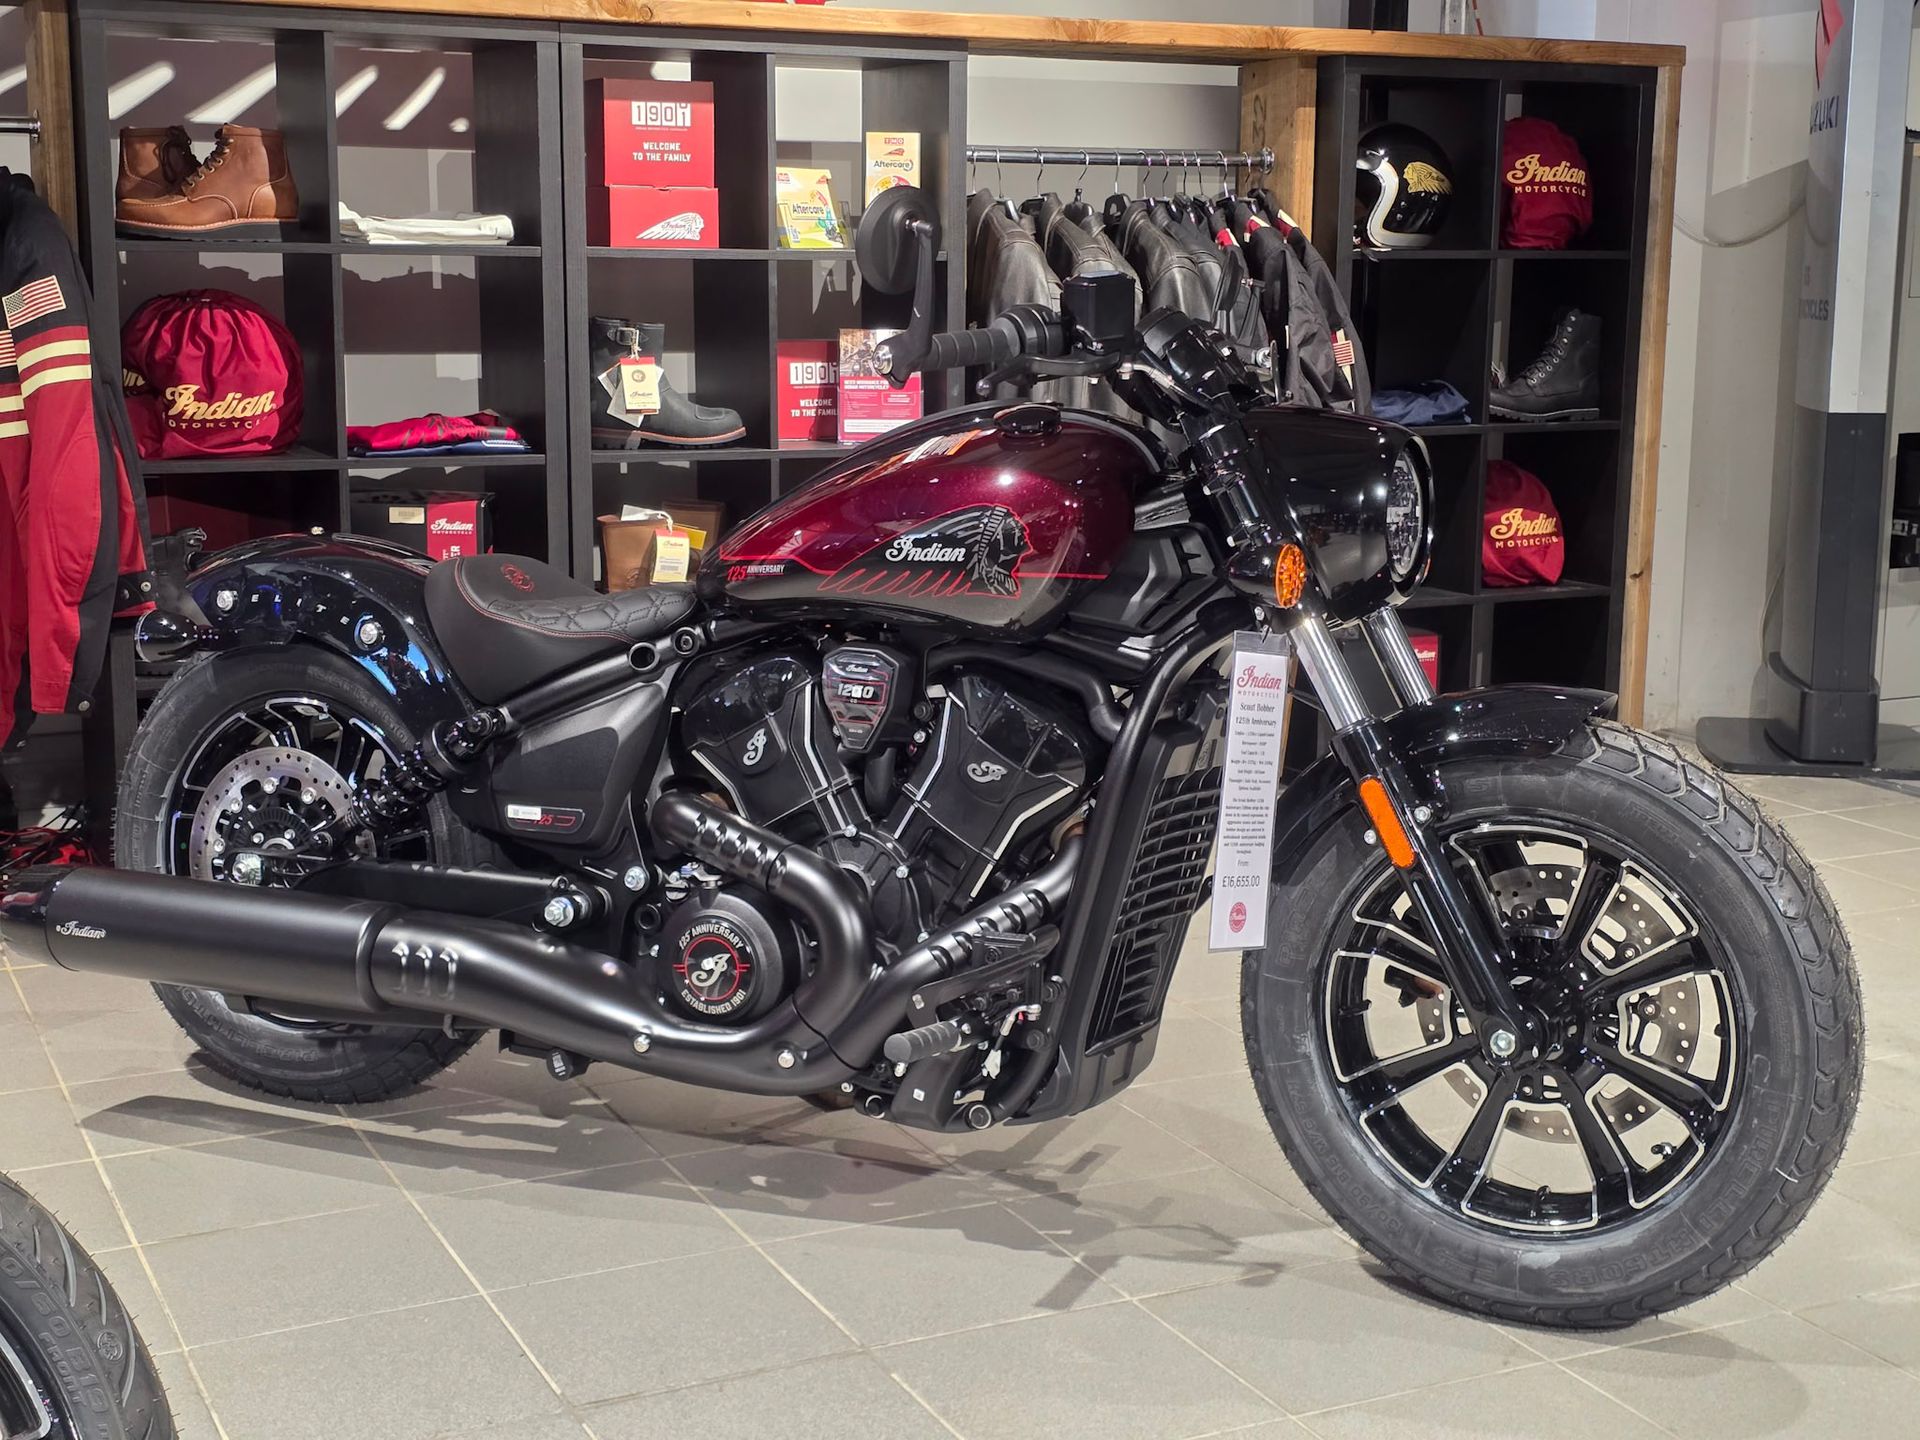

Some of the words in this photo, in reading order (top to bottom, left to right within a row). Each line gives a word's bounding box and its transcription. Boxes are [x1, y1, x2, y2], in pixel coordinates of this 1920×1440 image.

[642, 141, 681, 151] WELCOME
[632, 151, 643, 161] TO
[645, 152, 662, 161] THE
[663, 153, 692, 162] FAMILY
[873, 160, 911, 169] Aftercare
[1506, 153, 1586, 186] Indian
[1514, 185, 1586, 197] MOTORCYCLE
[792, 203, 825, 215] Aftercare
[165, 384, 276, 420] Indian
[799, 398, 833, 407] WELCOME
[790, 409, 800, 417] TO
[802, 409, 816, 417] THE
[430, 518, 474, 531] Indian
[885, 534, 967, 562] Indian
[746, 564, 785, 574] ANNIVERSARY
[1236, 664, 1282, 690] Indian
[1239, 702, 1256, 712] Scout
[1256, 703, 1275, 713] Bobber
[1222, 875, 1261, 889] £16,655.00
[60, 920, 102, 939] Indian
[691, 923, 744, 950] ANNIVERSARY
[681, 989, 733, 1015] ESTABLISHED
[732, 989, 747, 1008] 1901
[38, 1331, 88, 1408] FRONT
